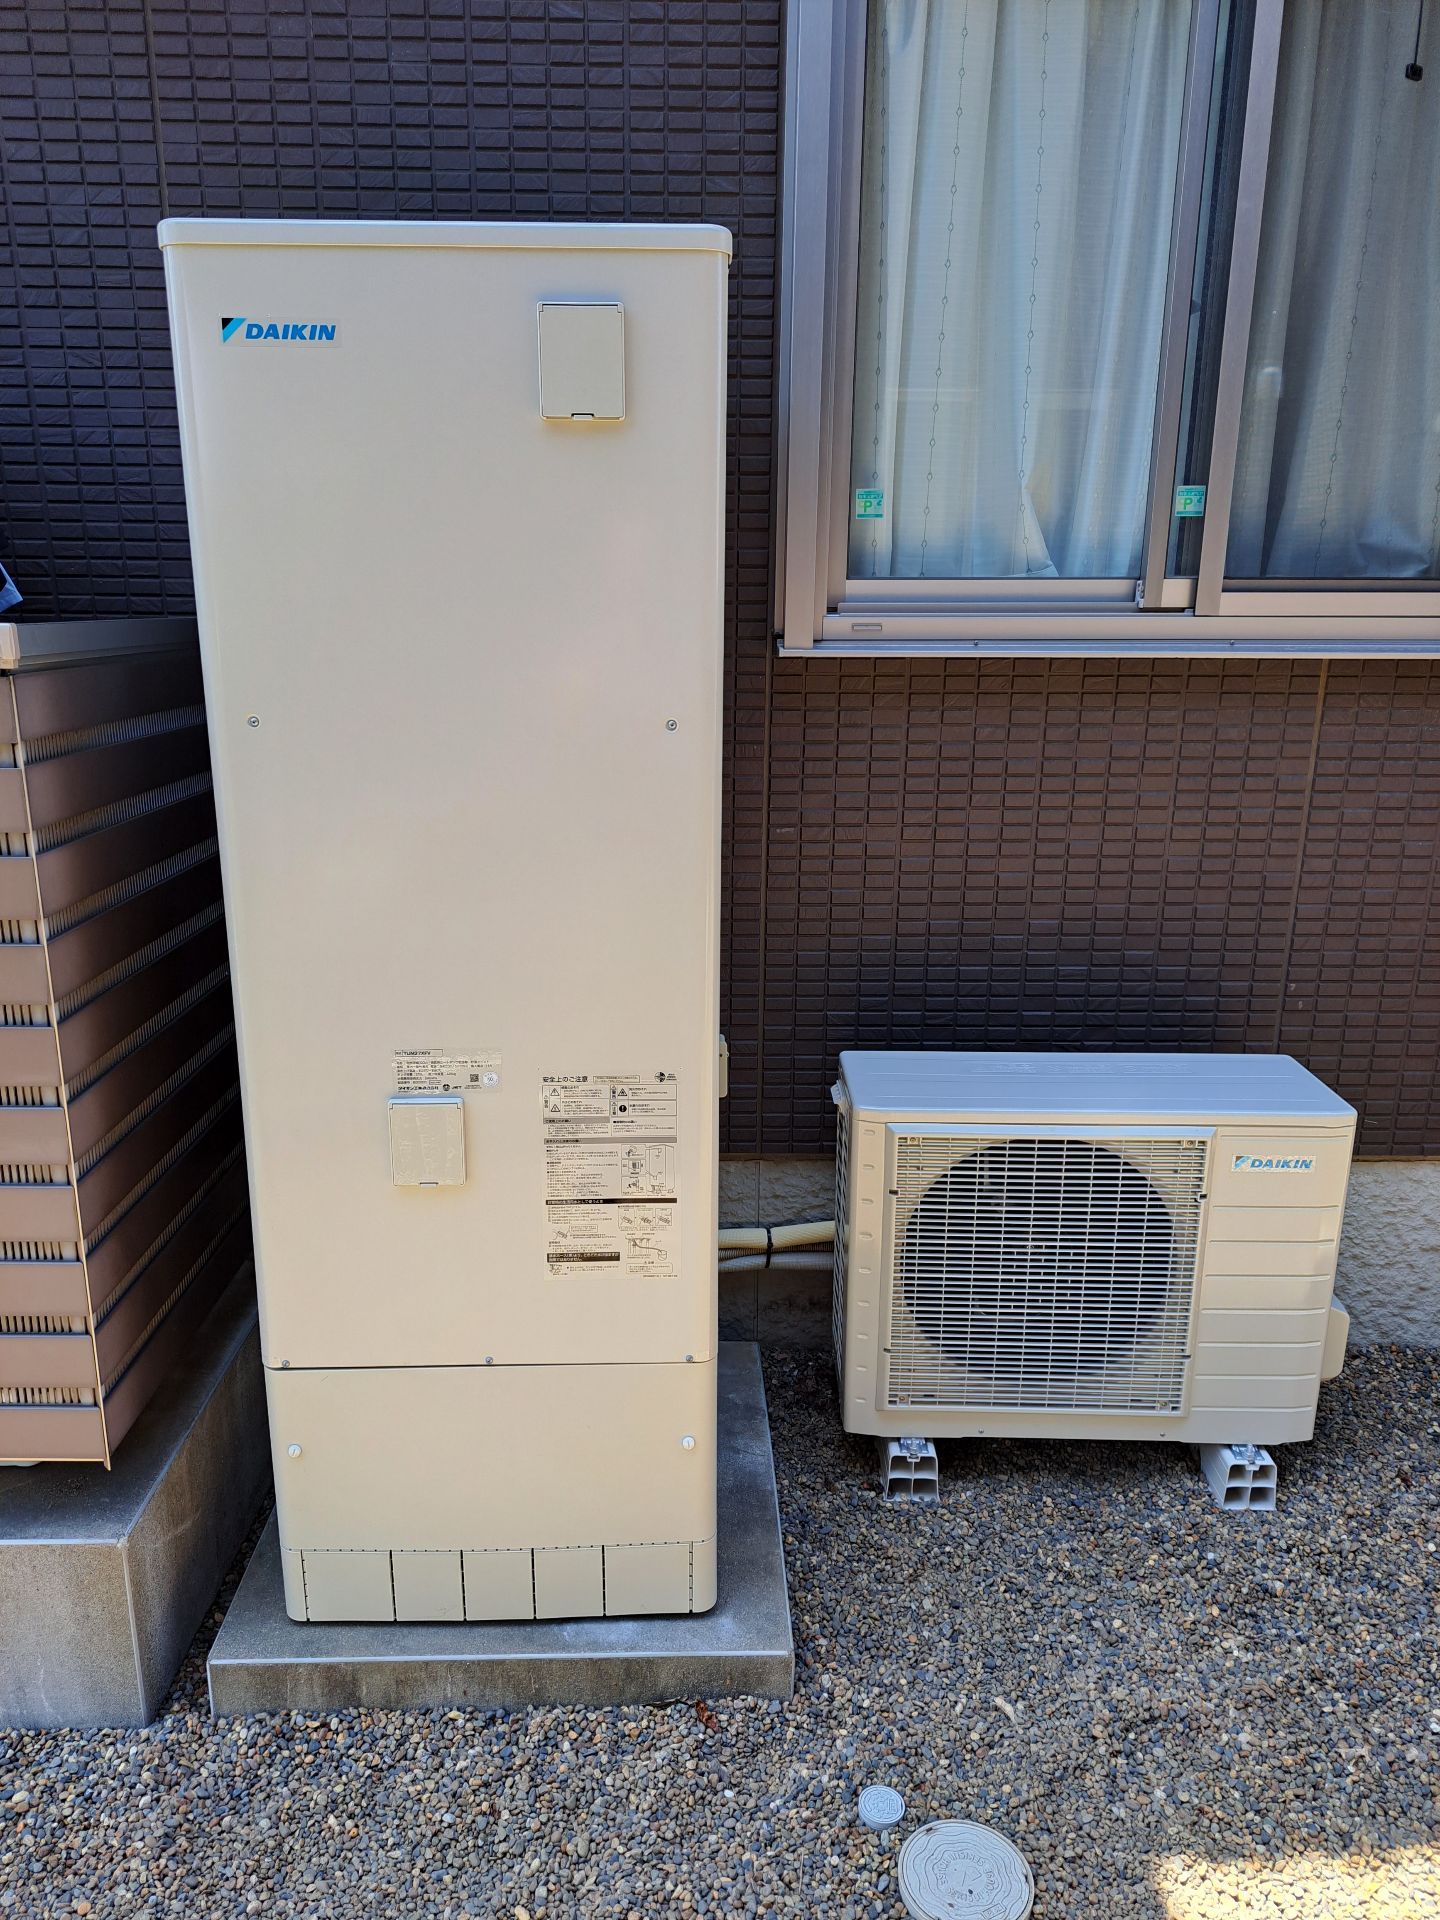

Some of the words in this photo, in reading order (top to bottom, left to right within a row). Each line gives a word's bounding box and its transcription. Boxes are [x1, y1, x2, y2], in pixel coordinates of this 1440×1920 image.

[245, 323, 337, 341] DAIKIN
[542, 1075, 589, 1083] 安全上のご注意
[1249, 1158, 1313, 1169] DAIKIN
